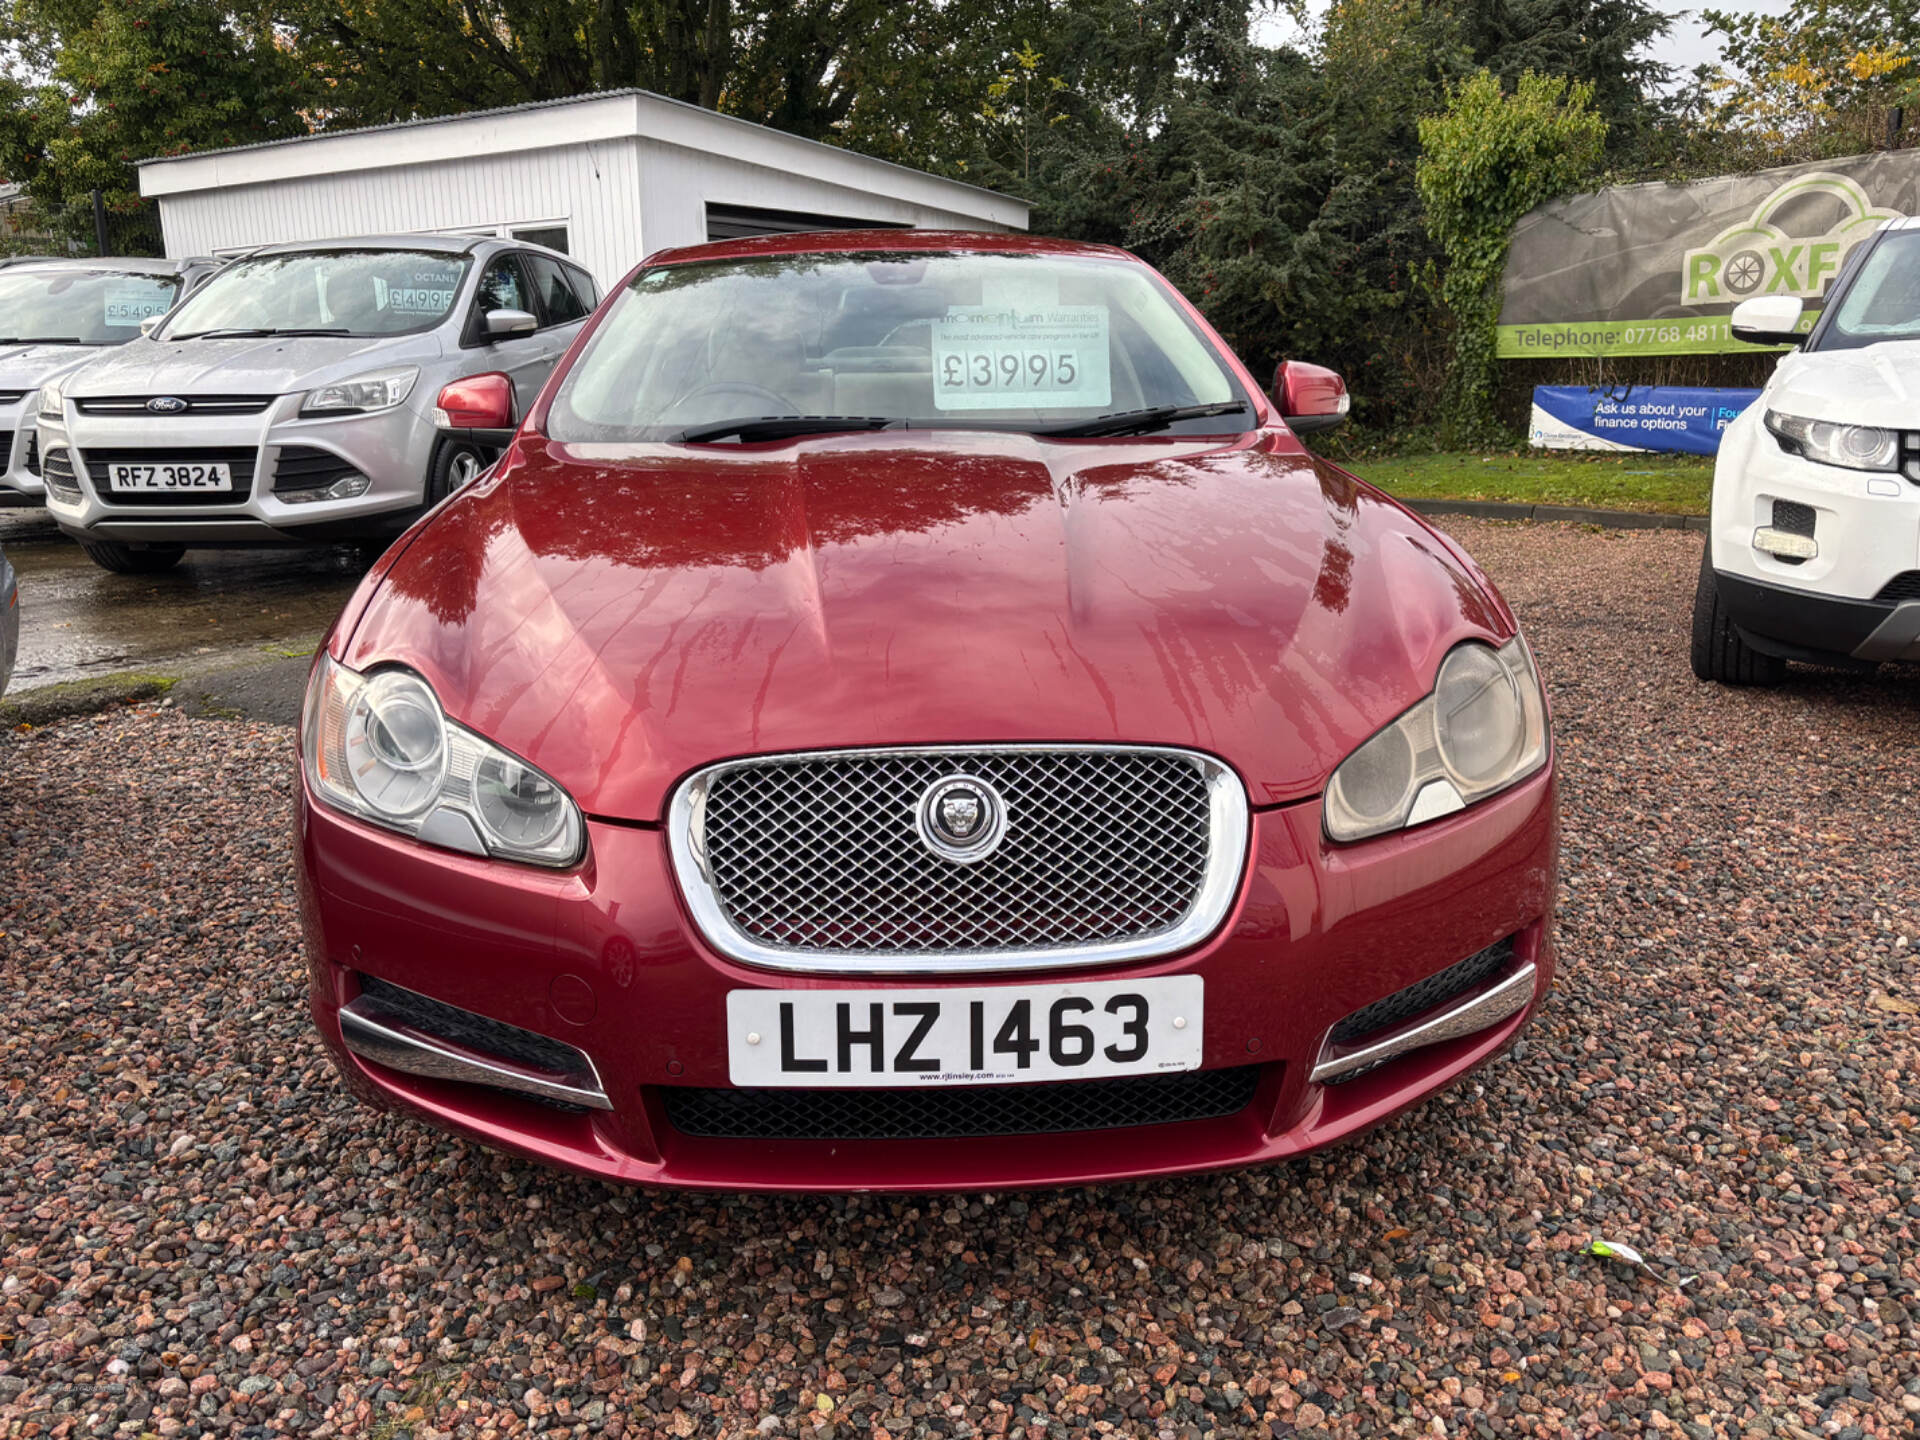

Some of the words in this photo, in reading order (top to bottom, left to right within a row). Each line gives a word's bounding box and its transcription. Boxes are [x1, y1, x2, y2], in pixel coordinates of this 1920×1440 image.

[415, 272, 456, 283] OCTANE
[1515, 328, 1621, 350] Telephone:
[1624, 326, 1681, 344] 07768
[943, 354, 1075, 387] £3995
[154, 400, 177, 410] Ford
[1595, 402, 1617, 414] Ask
[1621, 405, 1635, 415] us
[1639, 403, 1675, 416] about
[1678, 406, 1707, 418] your
[1594, 416, 1639, 429] finance
[1641, 418, 1687, 431] options
[117, 467, 158, 487] RFZ
[163, 466, 221, 487] 3824
[779, 1002, 941, 1073] LHZ
[969, 993, 1149, 1071] 1463
